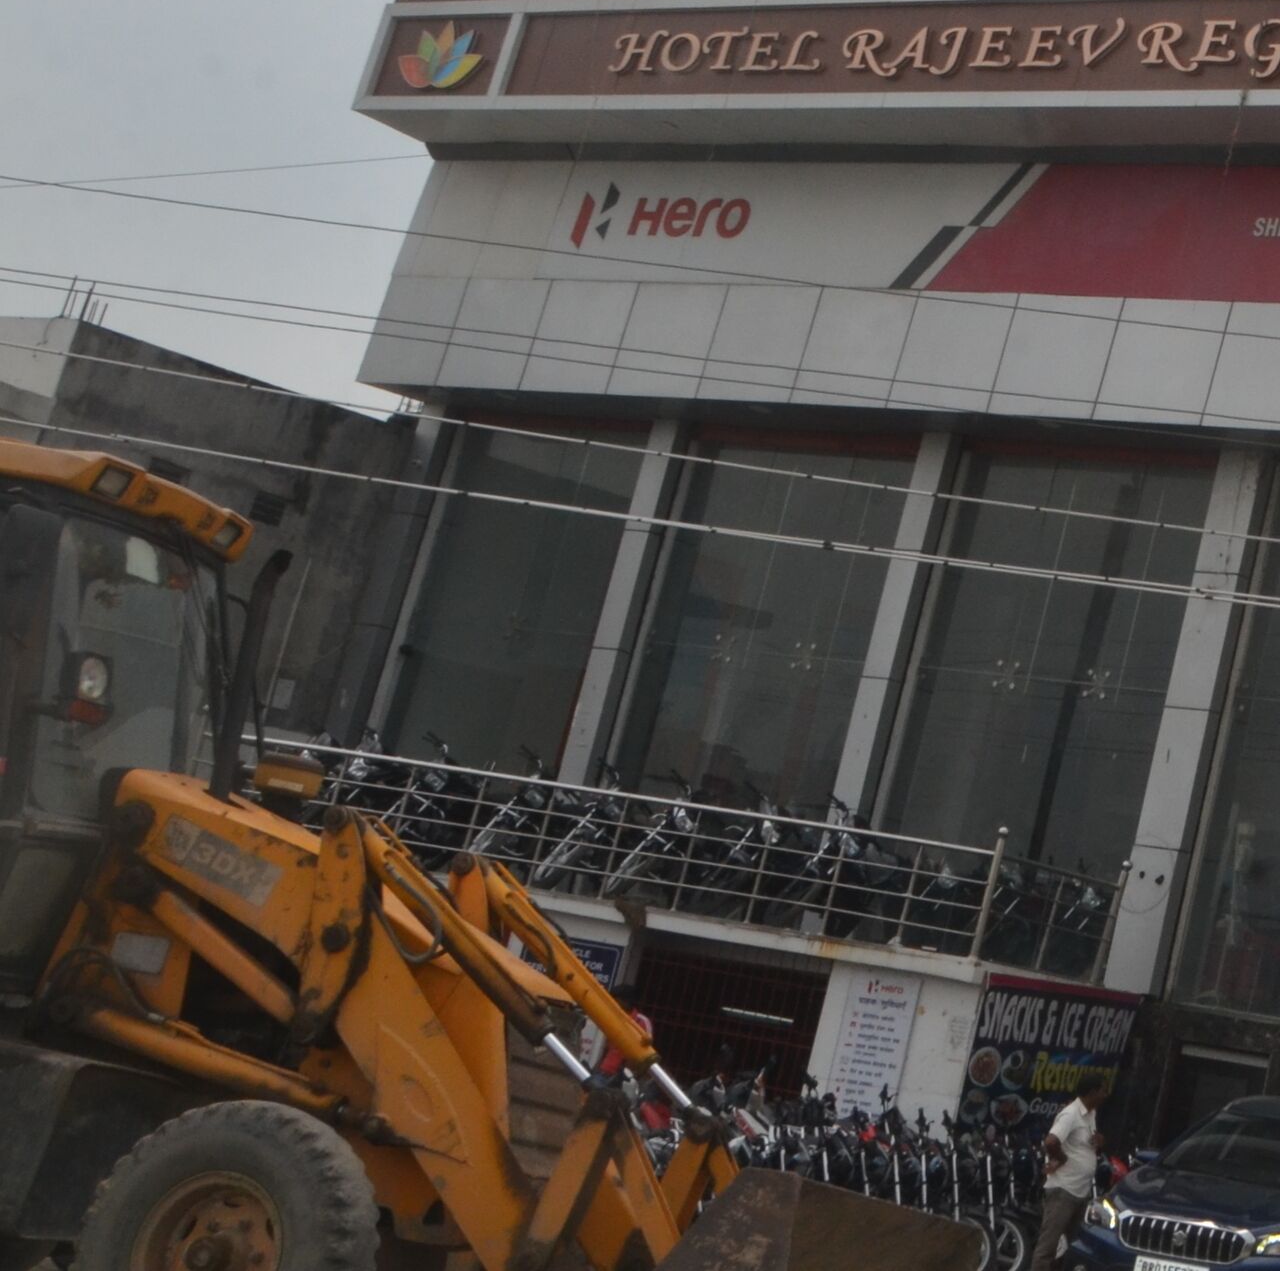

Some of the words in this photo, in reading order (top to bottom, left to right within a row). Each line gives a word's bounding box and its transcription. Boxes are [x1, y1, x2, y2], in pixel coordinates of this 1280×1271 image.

[607, 26, 822, 73] HOTEL
[843, 17, 1125, 78] RAJEEV
[626, 197, 752, 239] Hero
[978, 991, 1046, 1045] SNACKS
[1041, 999, 1058, 1046] &
[1056, 1001, 1086, 1049] ICE
[1083, 1005, 1136, 1055] CREAM
